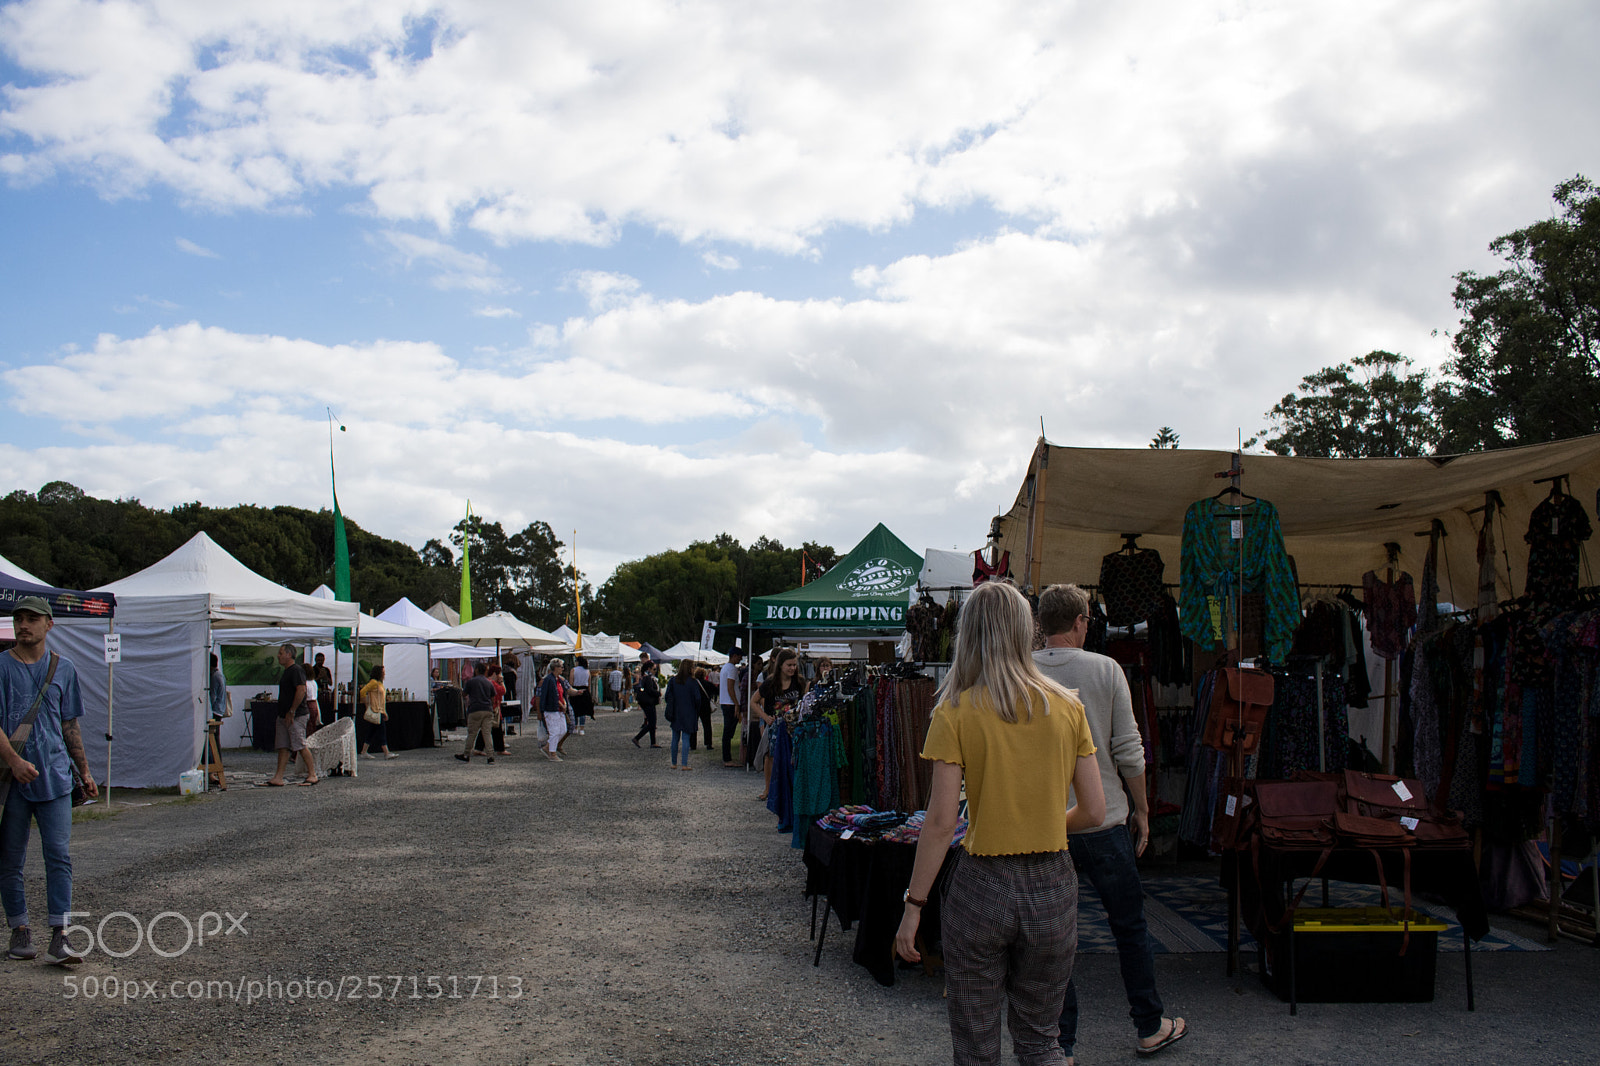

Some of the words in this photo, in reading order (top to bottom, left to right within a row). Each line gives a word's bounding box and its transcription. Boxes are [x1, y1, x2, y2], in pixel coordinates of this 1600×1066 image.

[853, 559, 888, 574] ECO
[838, 568, 912, 589] CHOPPING
[855, 579, 902, 591] BOARDS
[766, 605, 801, 619] ECO
[806, 606, 903, 621] CHOPPING
